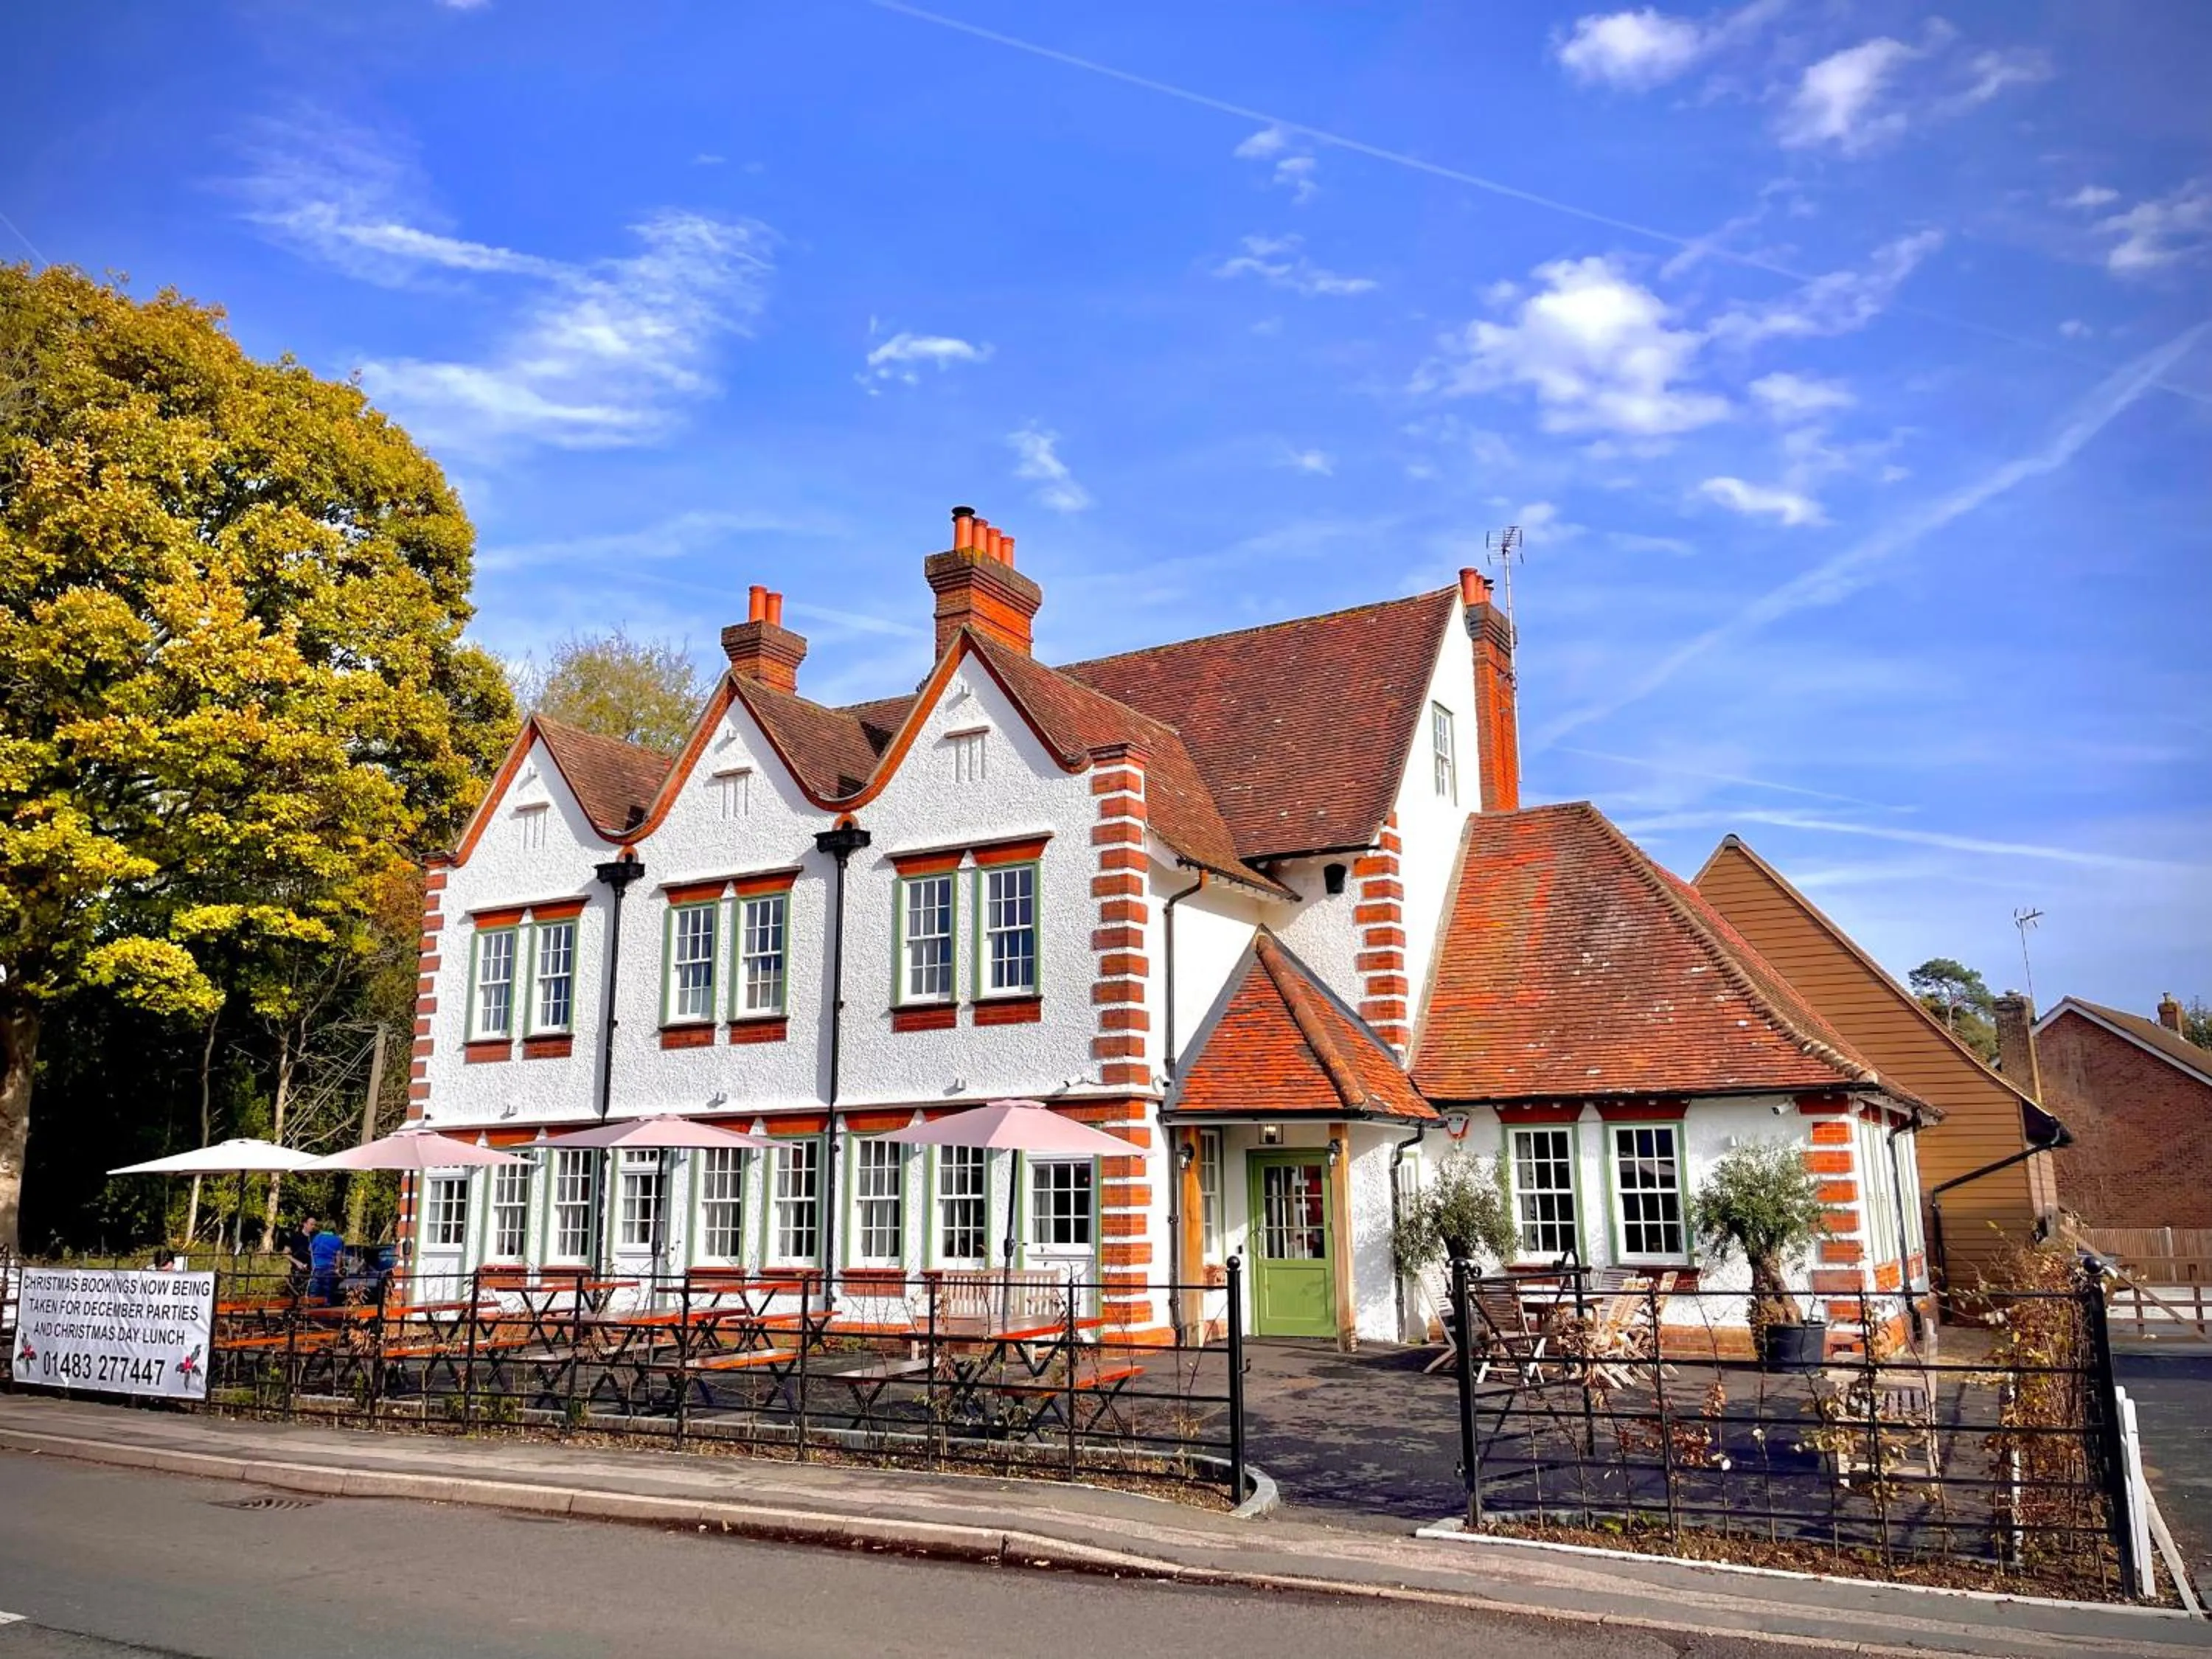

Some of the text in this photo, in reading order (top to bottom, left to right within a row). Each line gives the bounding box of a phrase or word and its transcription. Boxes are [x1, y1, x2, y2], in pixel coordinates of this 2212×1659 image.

[24, 1276, 210, 1296] CHRISTMAS BOOKINGS NOW BEING
[29, 1298, 198, 1321] TAKEN FOR DECEMBER PARTIES
[34, 1321, 184, 1345] AND CHRISTMAS DAY LUNCH
[44, 1351, 165, 1385] 01483 277447
